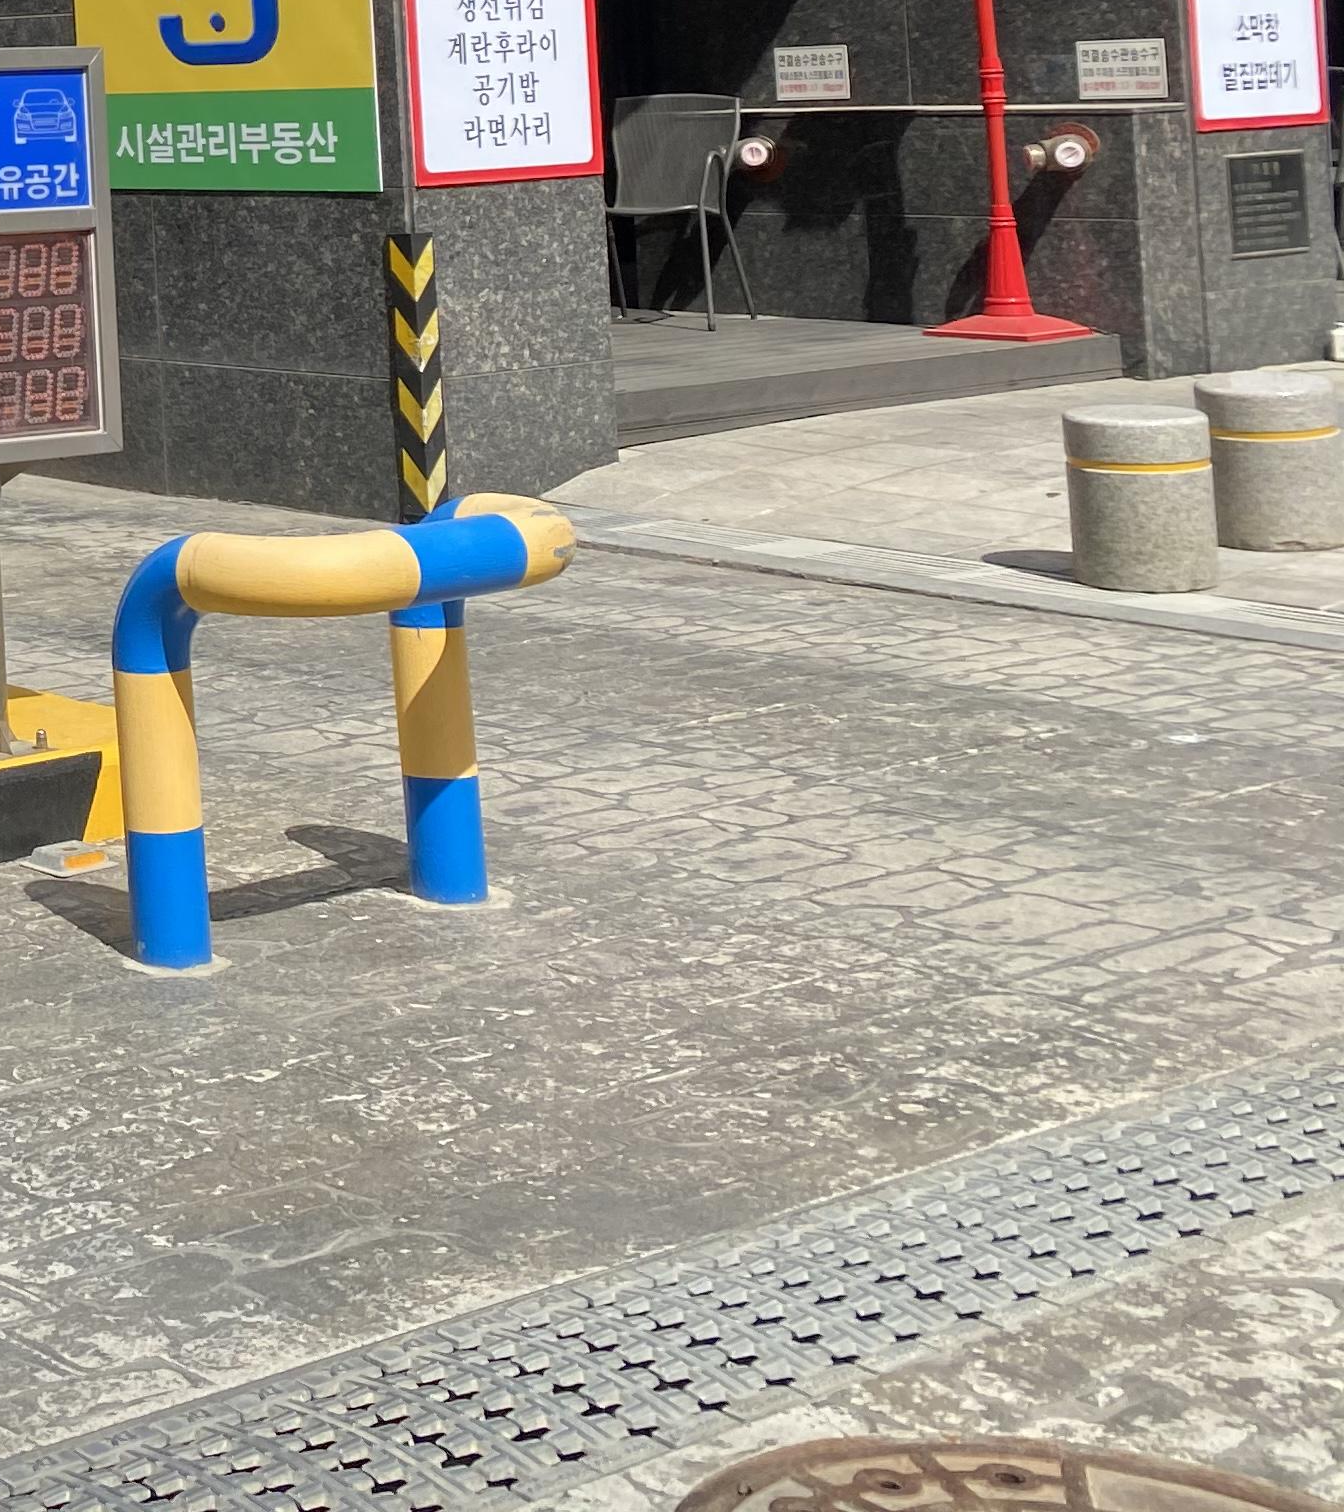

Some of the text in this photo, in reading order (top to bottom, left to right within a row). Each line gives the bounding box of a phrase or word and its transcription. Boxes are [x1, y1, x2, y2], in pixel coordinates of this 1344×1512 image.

[1236, 13, 1280, 42] 소막창
[448, 29, 558, 65] 계란후라이
[473, 71, 539, 106] 공기밥
[116, 121, 339, 165] 시설관리부동산
[464, 112, 552, 149] 라면사리
